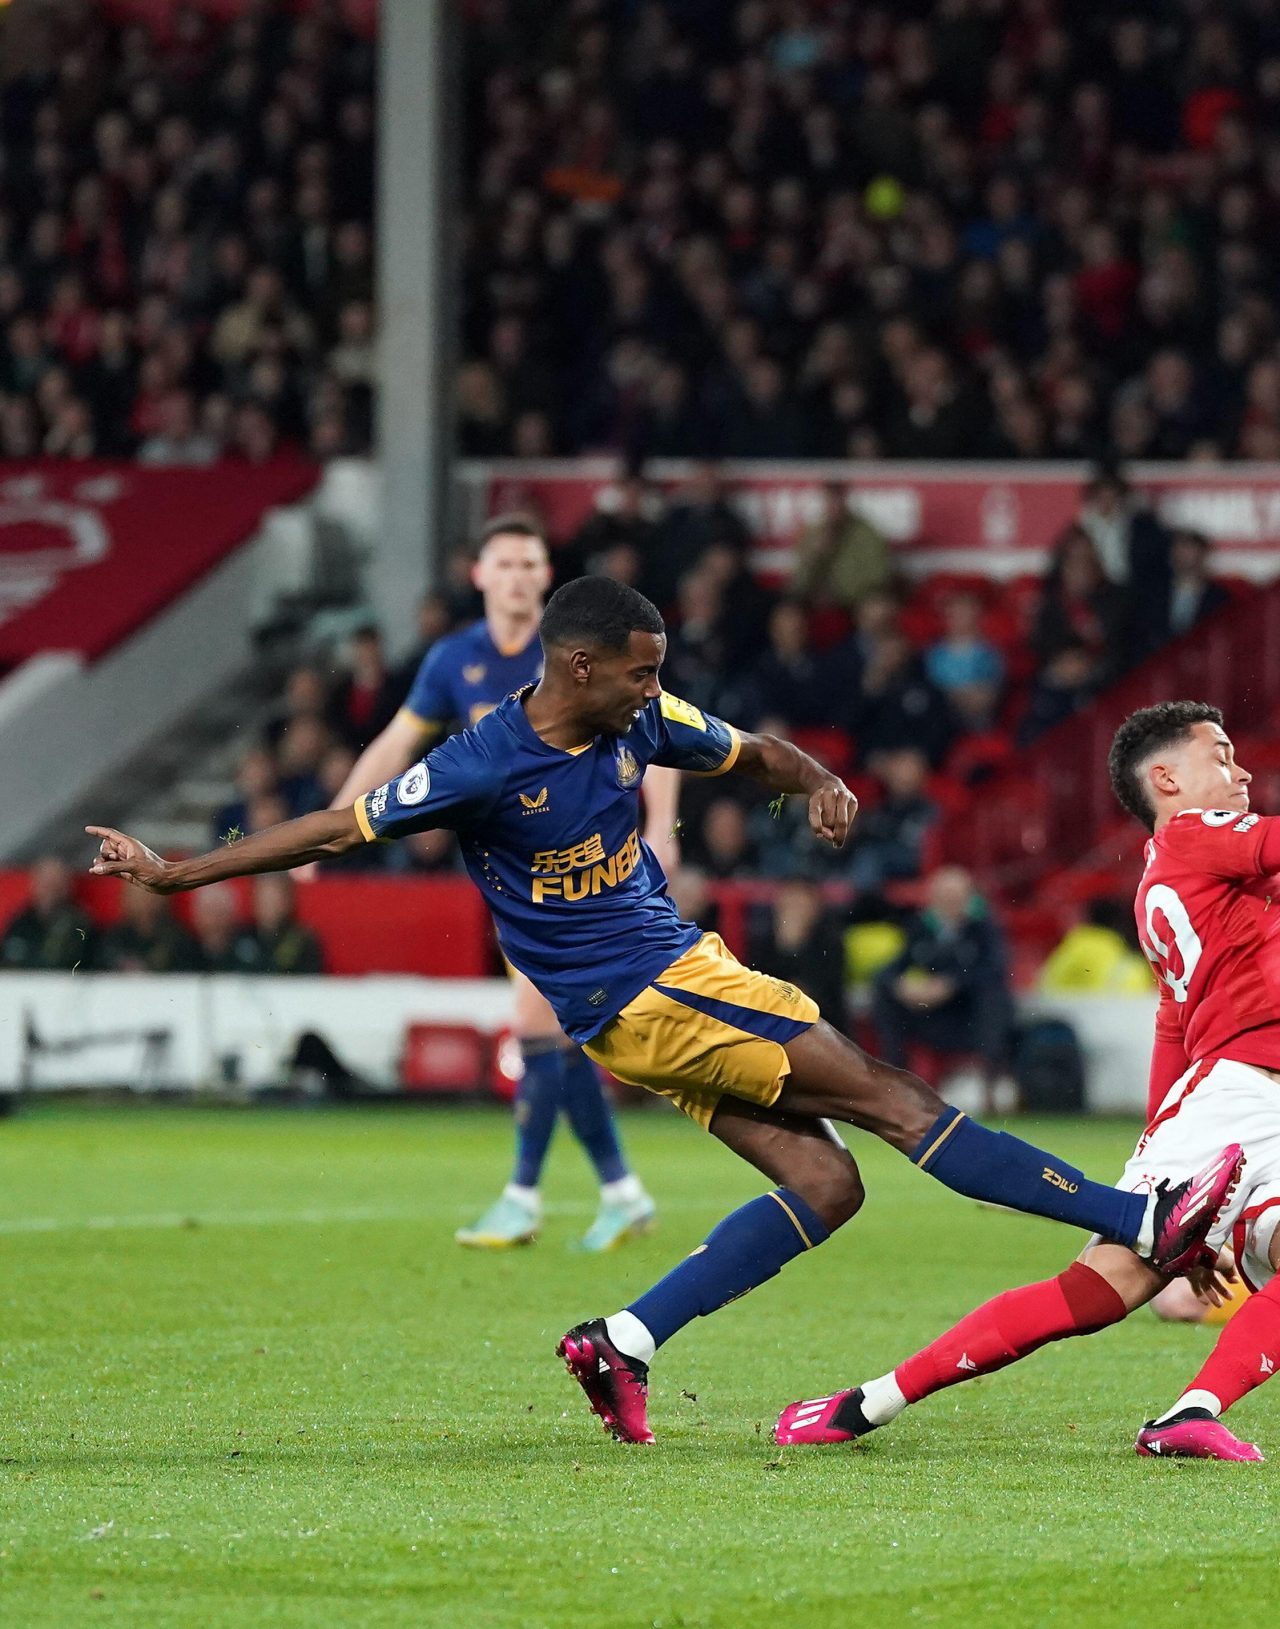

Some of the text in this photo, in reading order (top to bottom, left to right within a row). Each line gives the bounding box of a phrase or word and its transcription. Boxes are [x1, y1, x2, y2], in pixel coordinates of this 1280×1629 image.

[531, 833, 606, 873] 乐天堂
[532, 827, 641, 903] FUN88
[1042, 1167, 1079, 1194] NUFC
